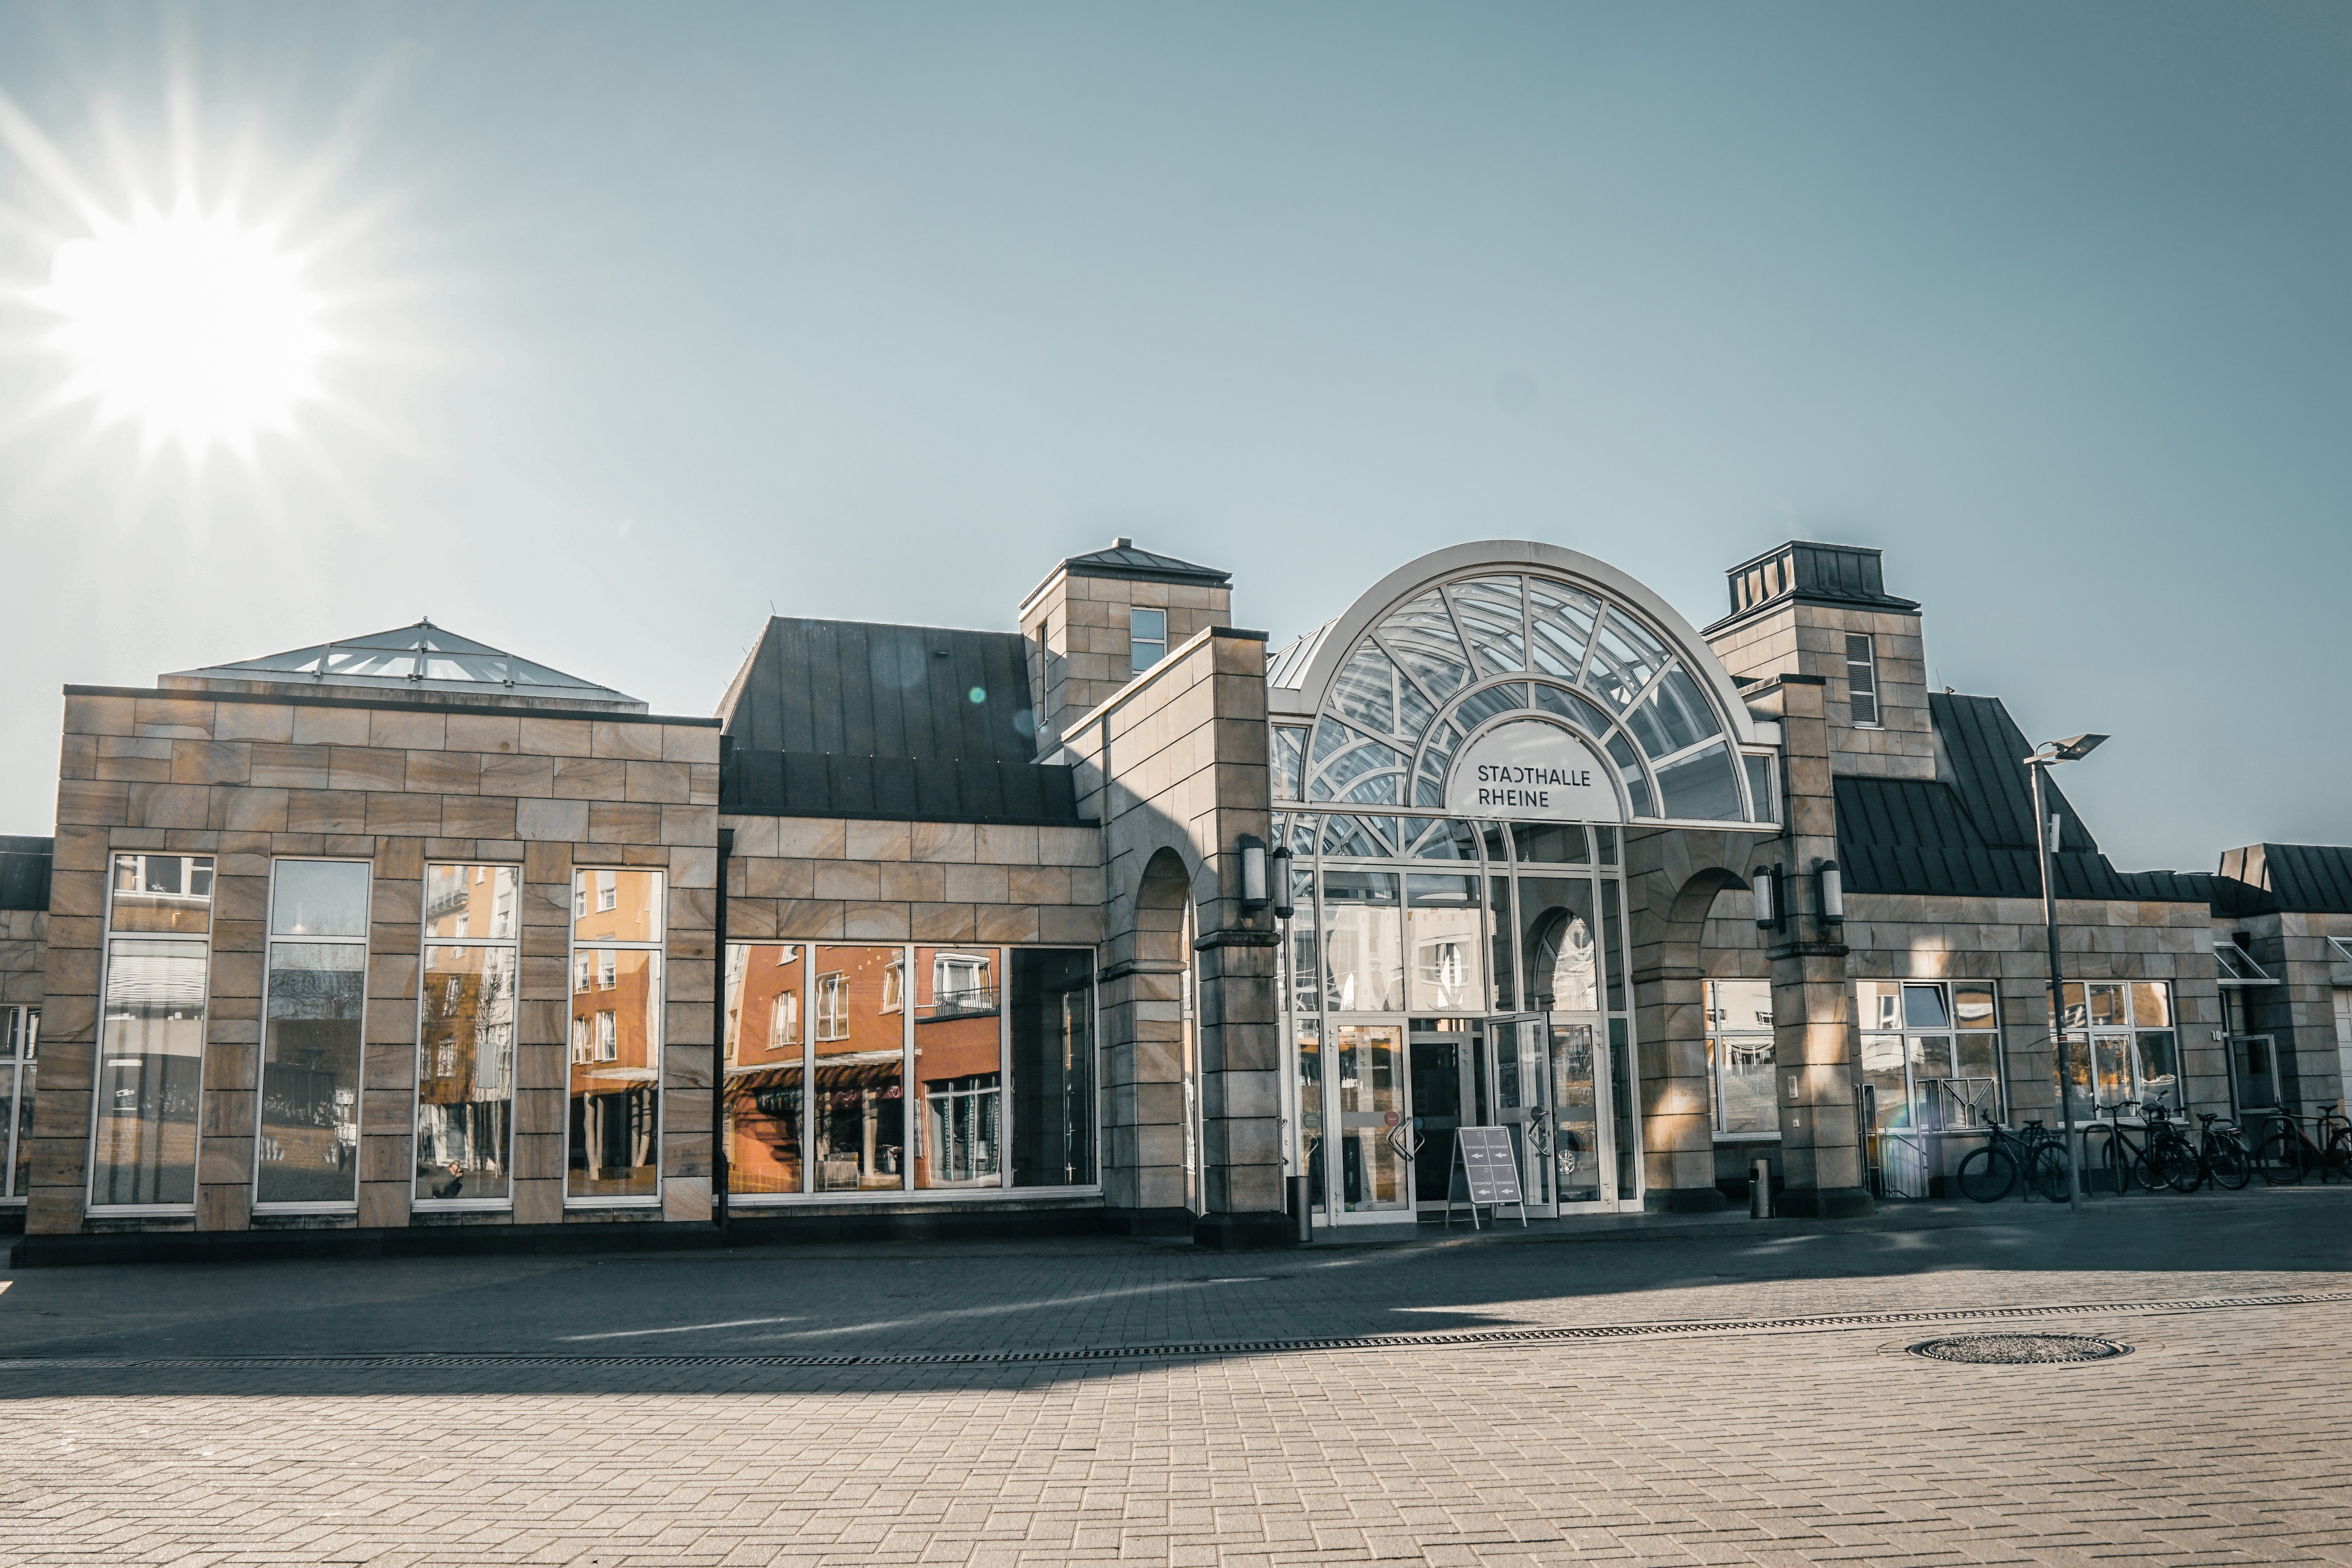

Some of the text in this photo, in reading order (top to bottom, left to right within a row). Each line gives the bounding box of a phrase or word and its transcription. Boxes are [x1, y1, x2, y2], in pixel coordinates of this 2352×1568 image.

[1478, 765, 1590, 787] STADTHALLE
[1479, 788, 1549, 807] RHEINE
[2211, 1031, 2221, 1040] 10
